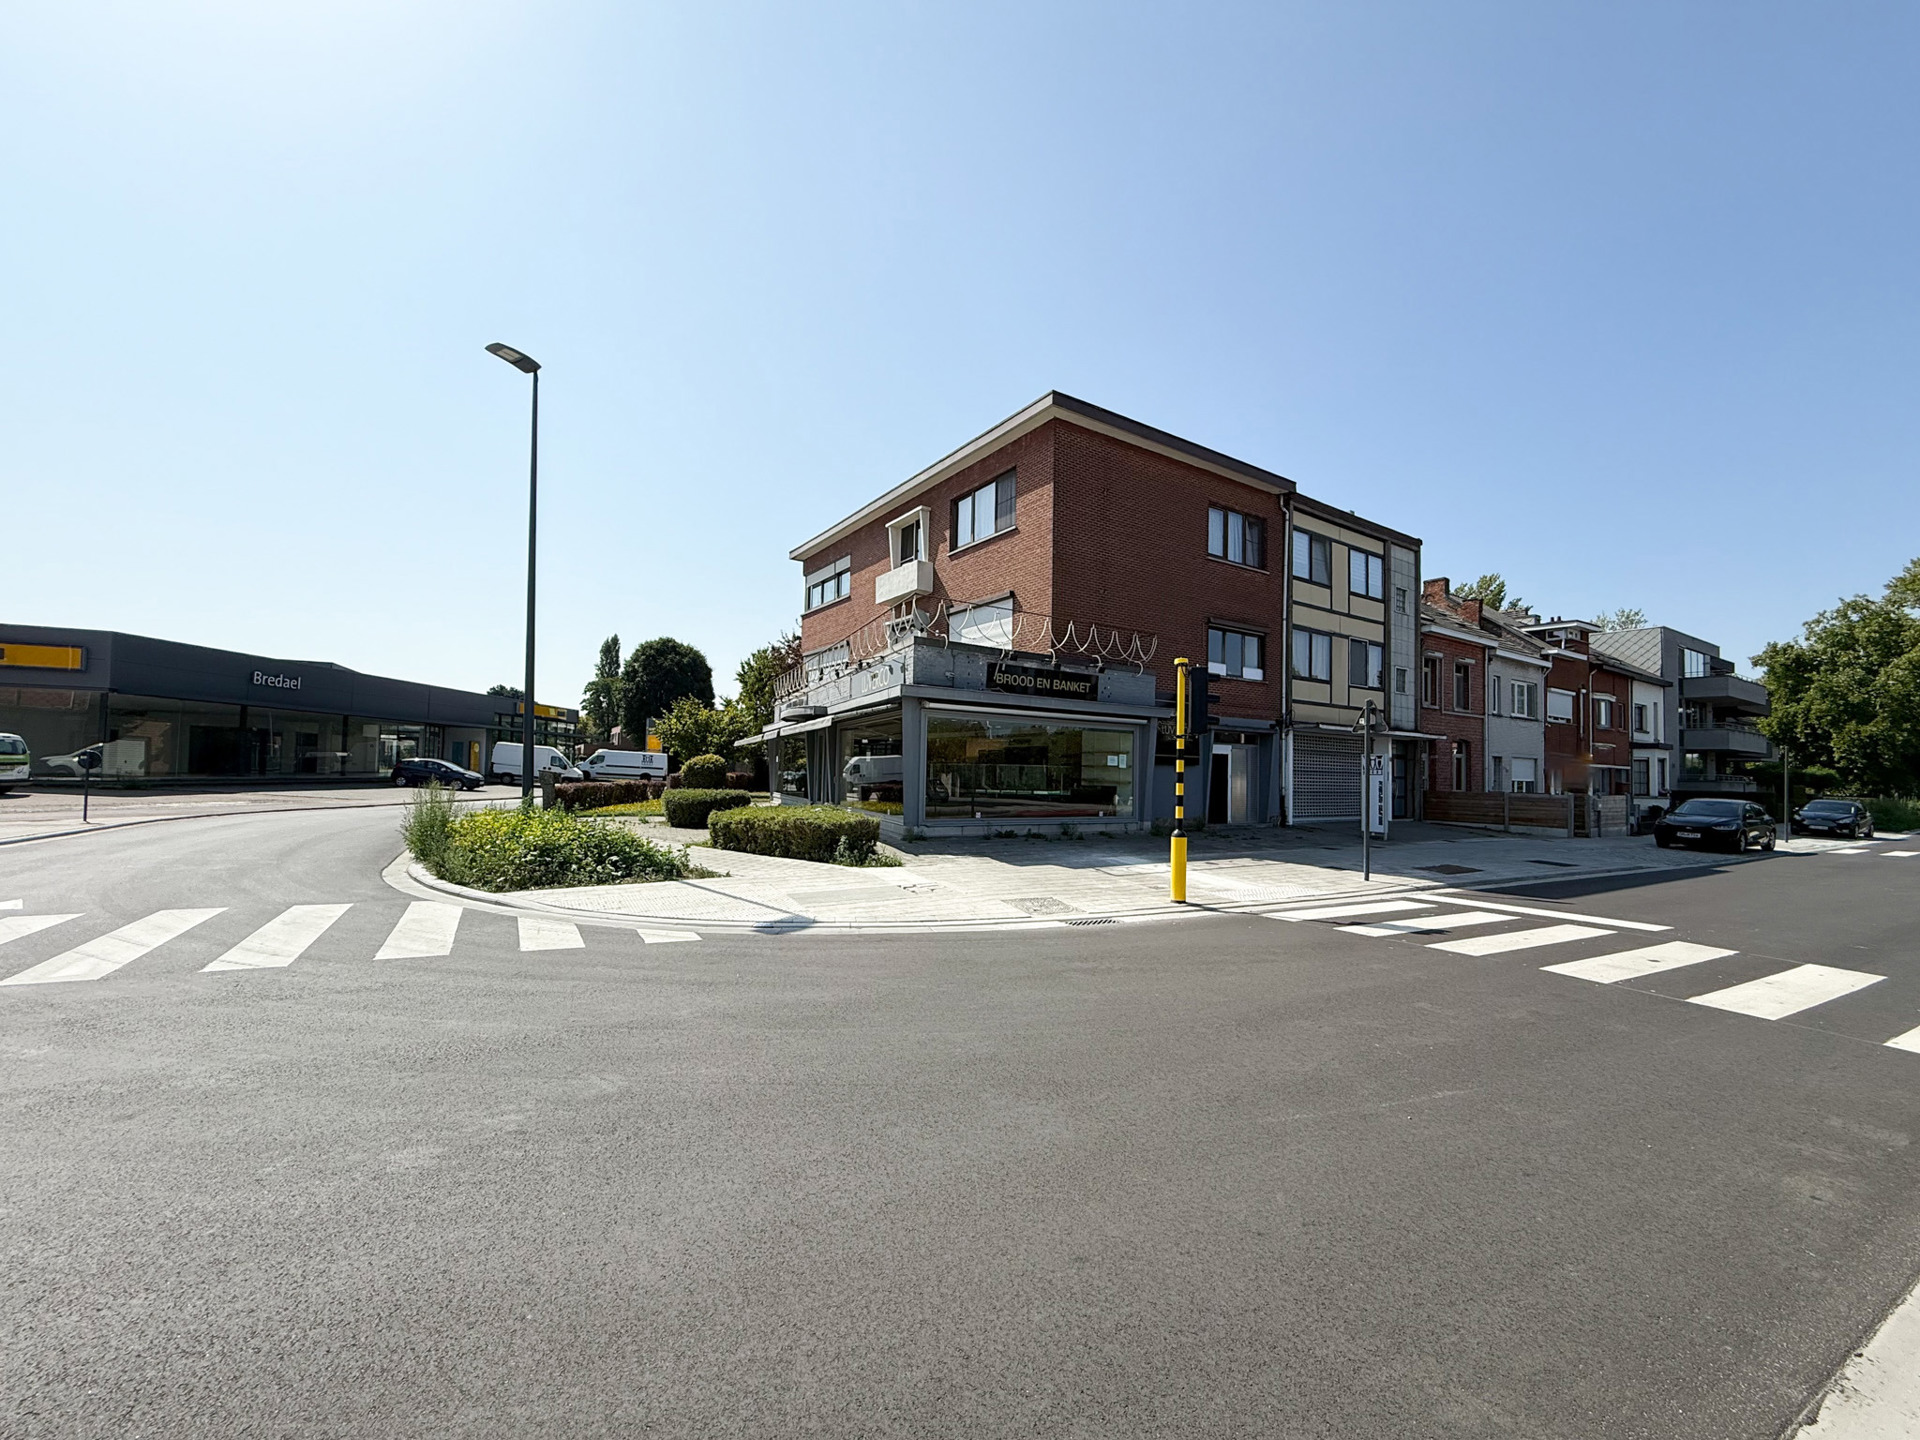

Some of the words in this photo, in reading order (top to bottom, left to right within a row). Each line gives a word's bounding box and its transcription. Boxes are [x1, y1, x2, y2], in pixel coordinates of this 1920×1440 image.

[253, 670, 302, 690] Bredael
[995, 673, 1035, 687] BROOD
[1036, 677, 1051, 690] EN
[1053, 679, 1092, 694] BANKET
